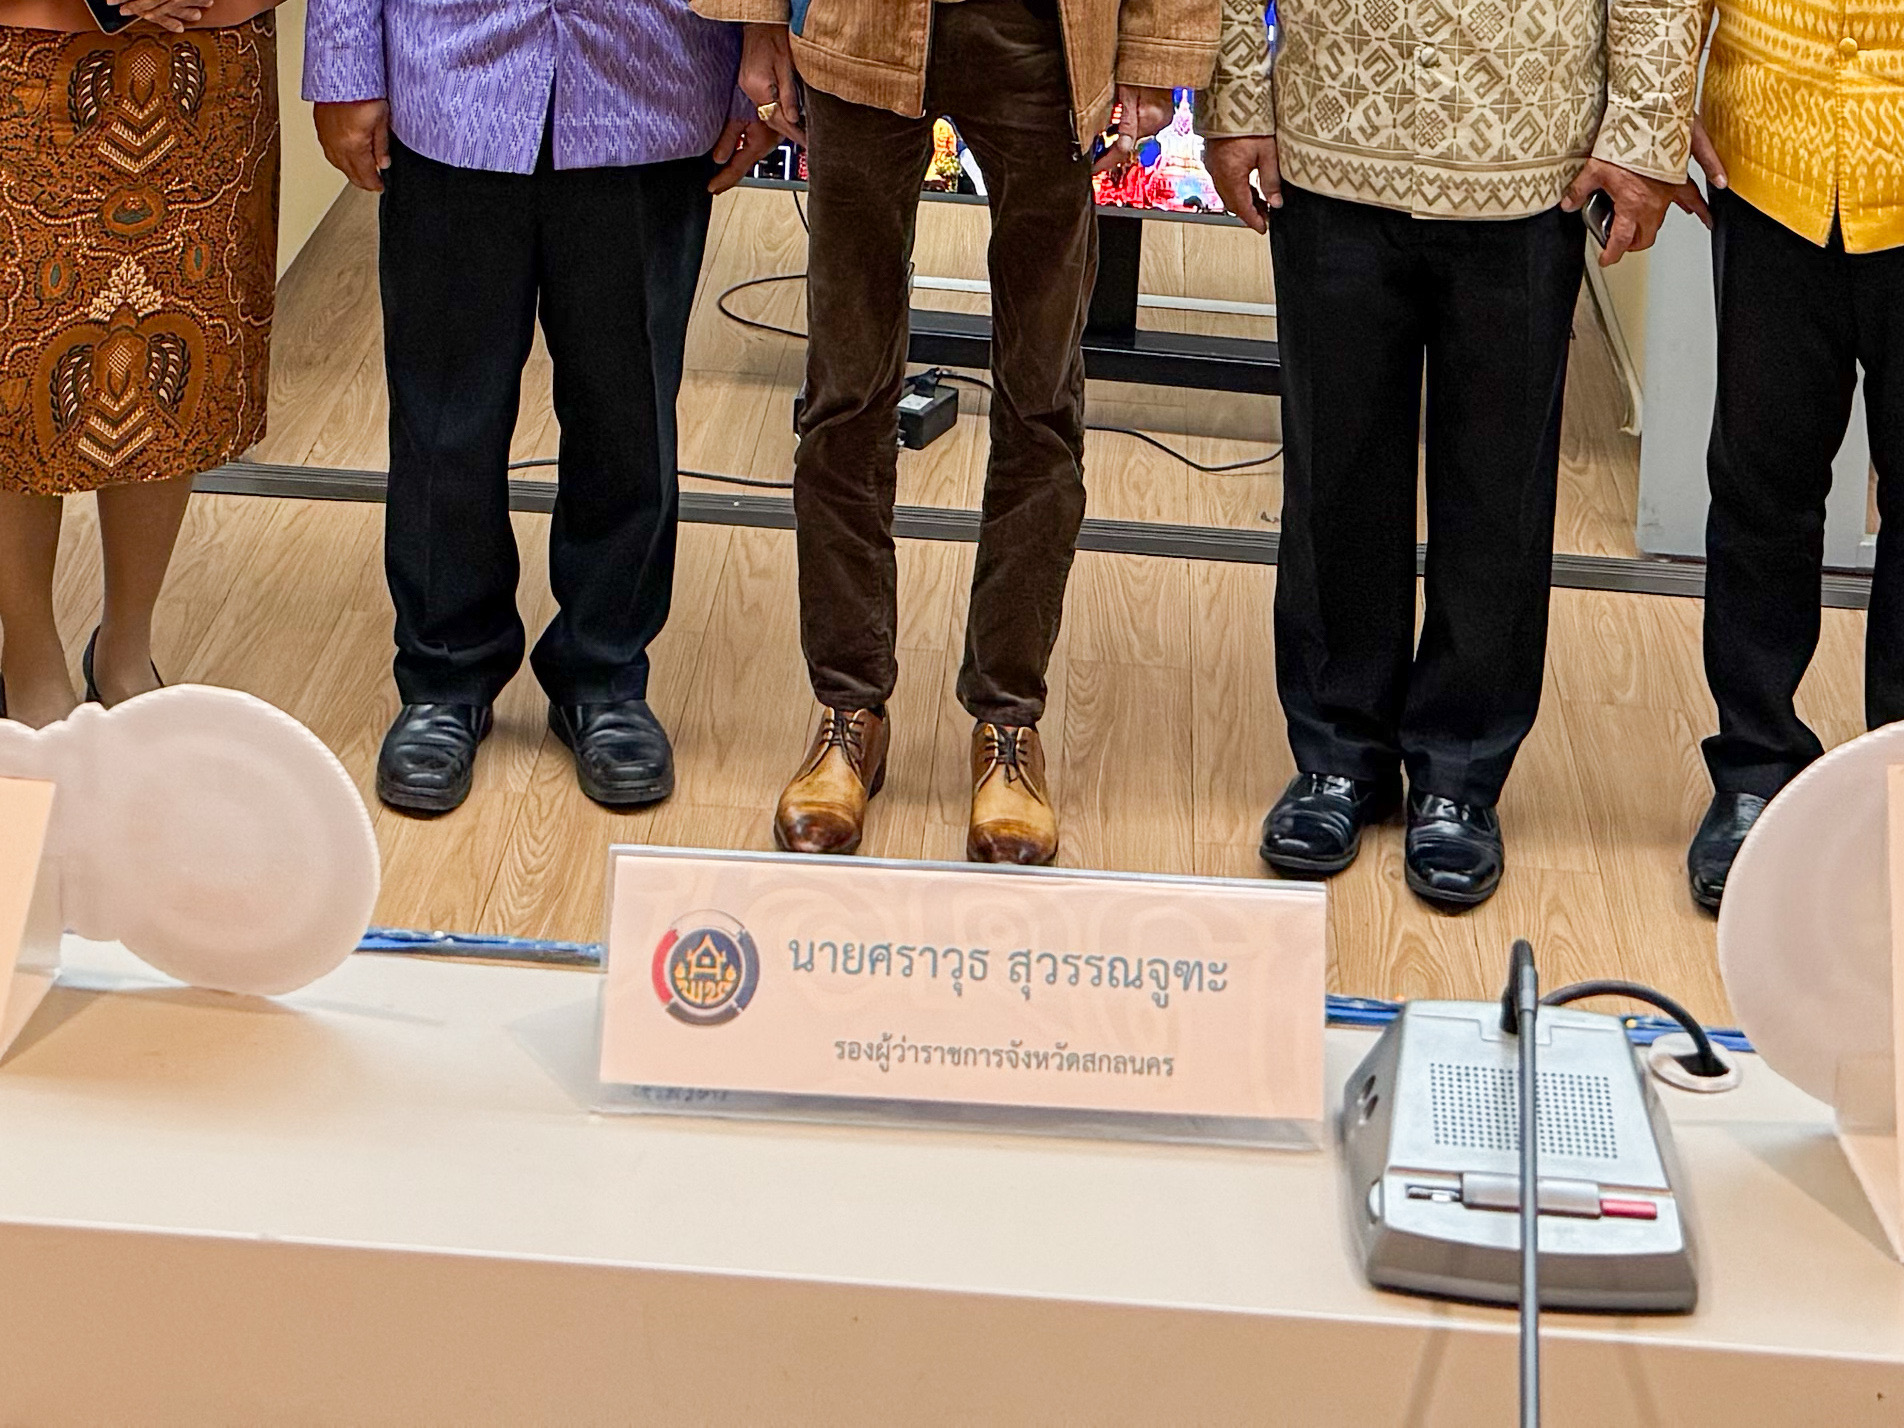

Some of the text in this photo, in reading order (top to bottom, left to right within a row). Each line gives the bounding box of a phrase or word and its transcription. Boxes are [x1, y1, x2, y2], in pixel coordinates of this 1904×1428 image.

[788, 938, 1229, 1010] นายศราวุธ สุวรรณจูฑะ
[834, 1032, 1176, 1078] รองผู้ว่าราชการจังหวัดสกลนคร
